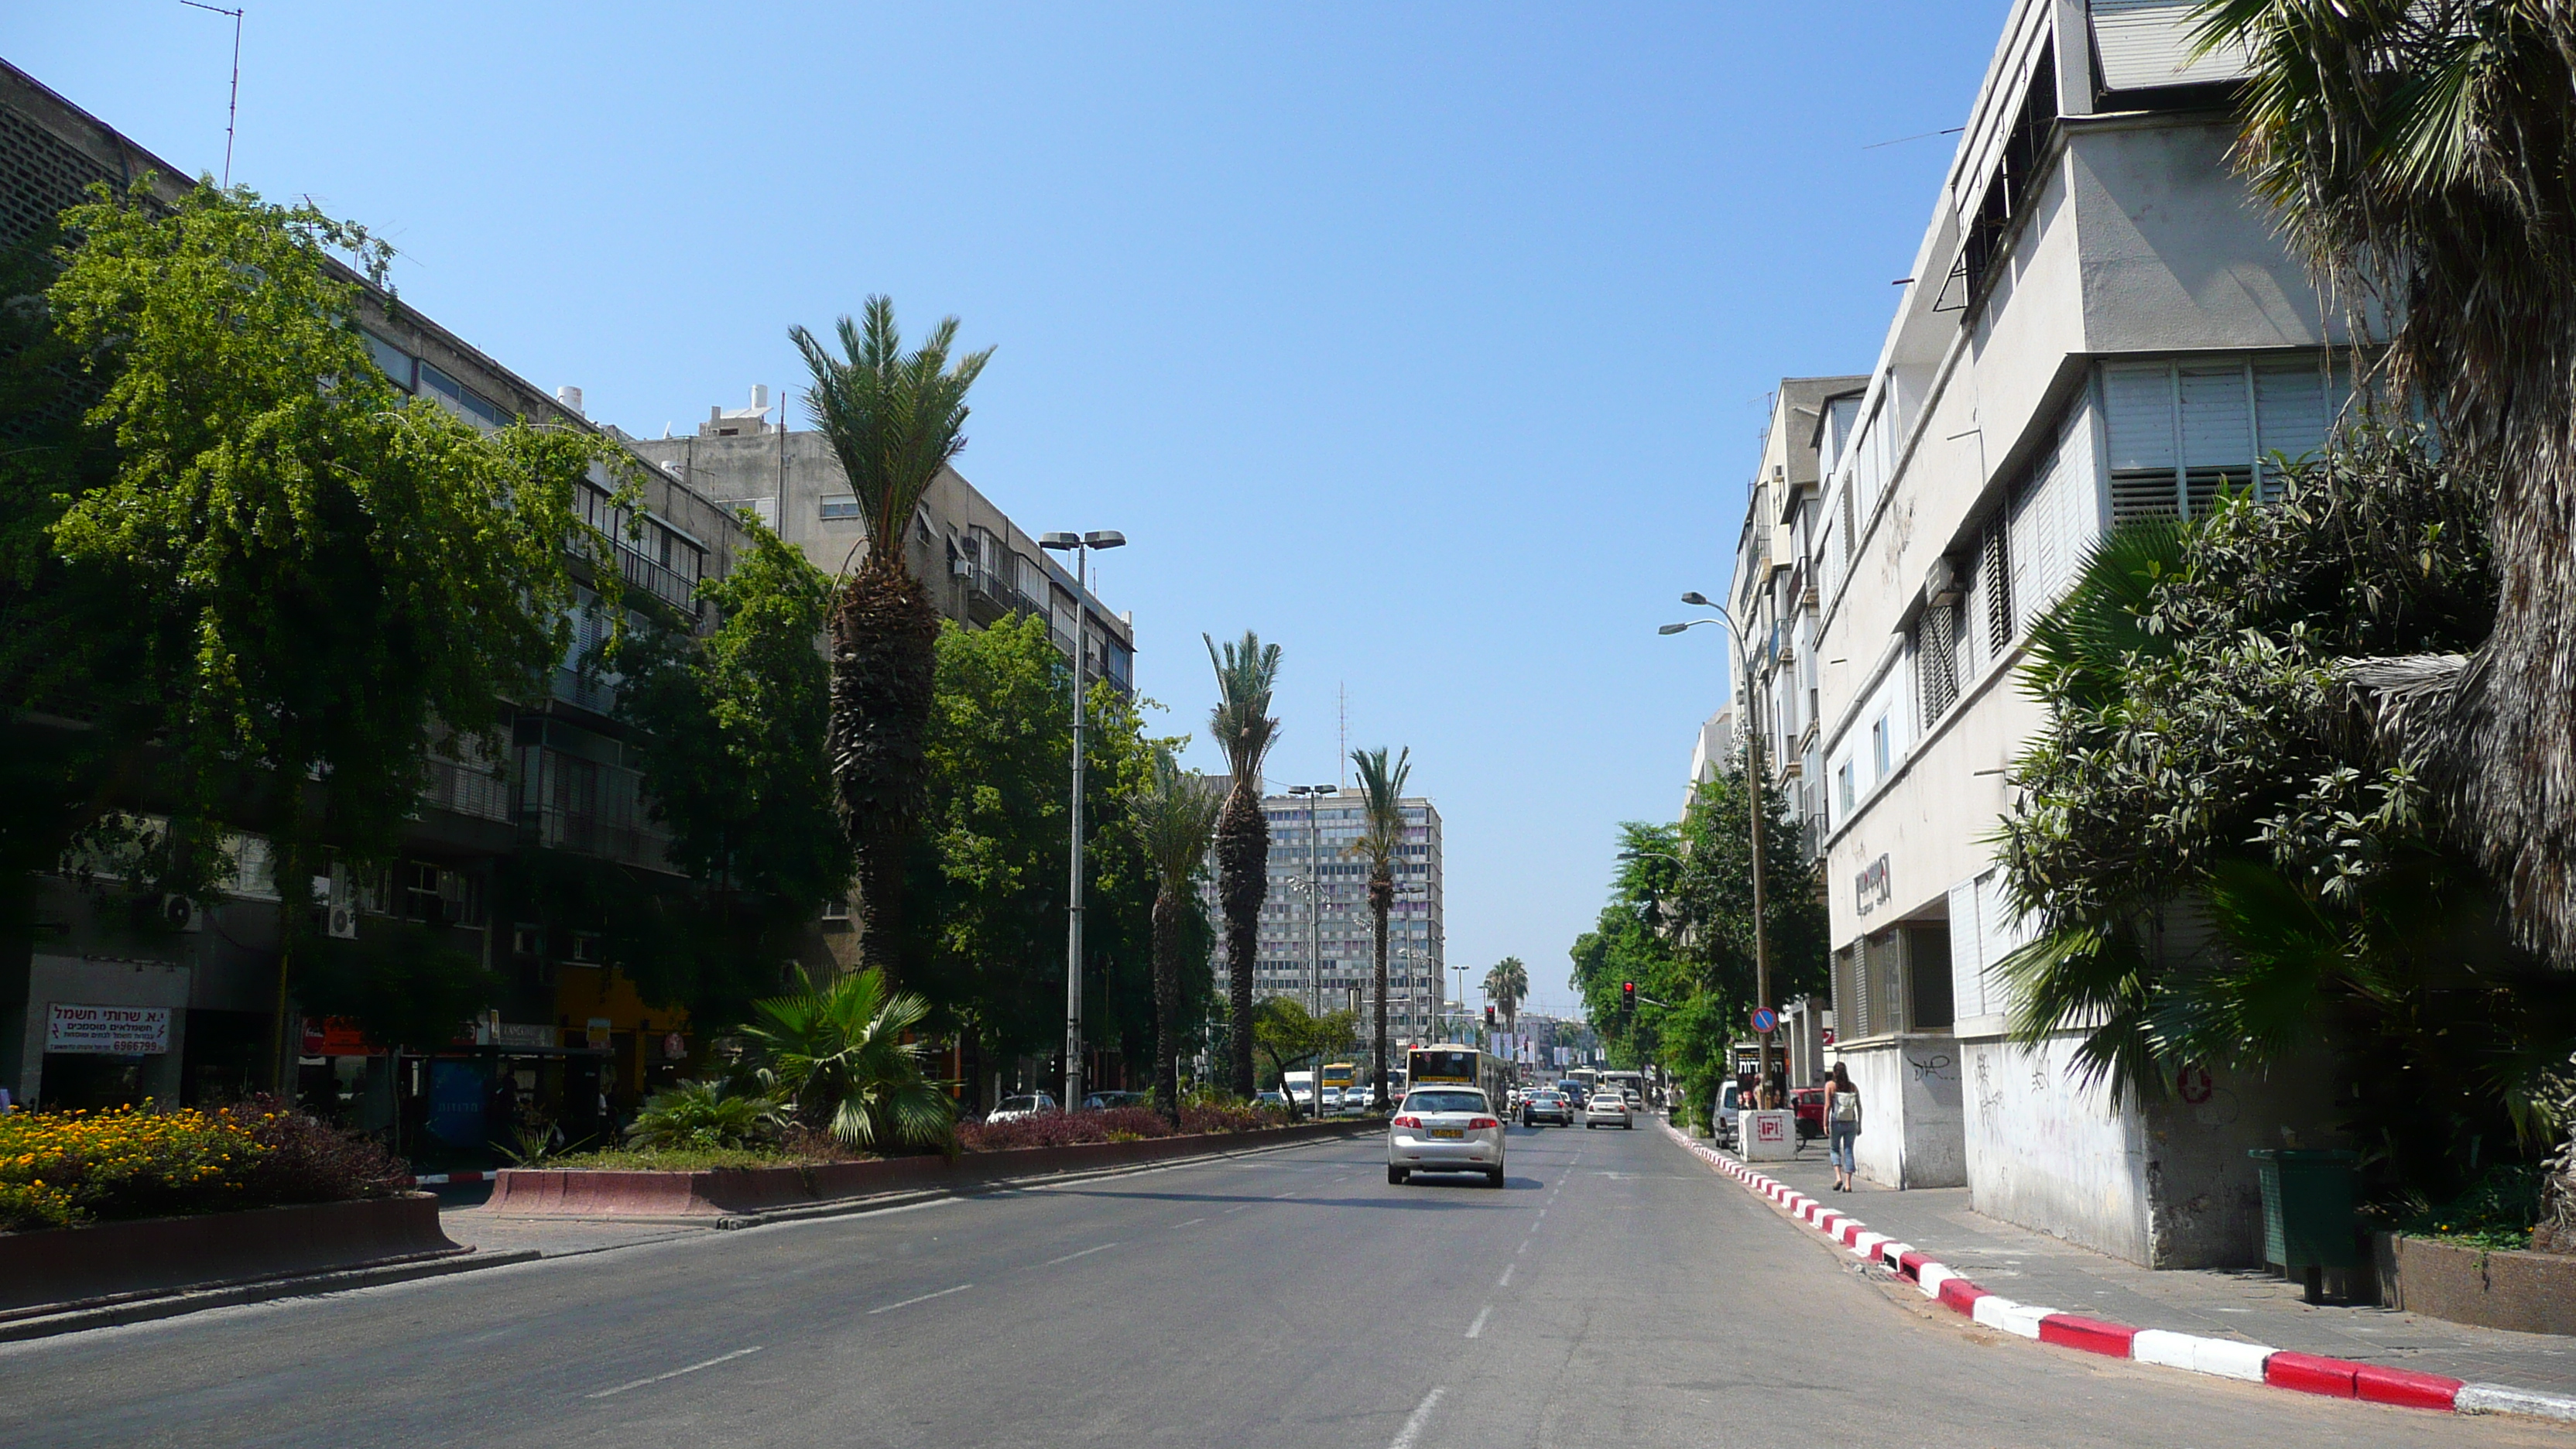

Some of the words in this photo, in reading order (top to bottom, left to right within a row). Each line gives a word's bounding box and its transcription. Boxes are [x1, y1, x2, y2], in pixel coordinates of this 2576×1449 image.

[54, 1005, 97, 1020] חשמל
[103, 1009, 141, 1022] שרותי
[67, 1022, 106, 1031] מוסמכים
[110, 1023, 152, 1032] חשמלאים
[114, 1040, 157, 1051] 6966799
